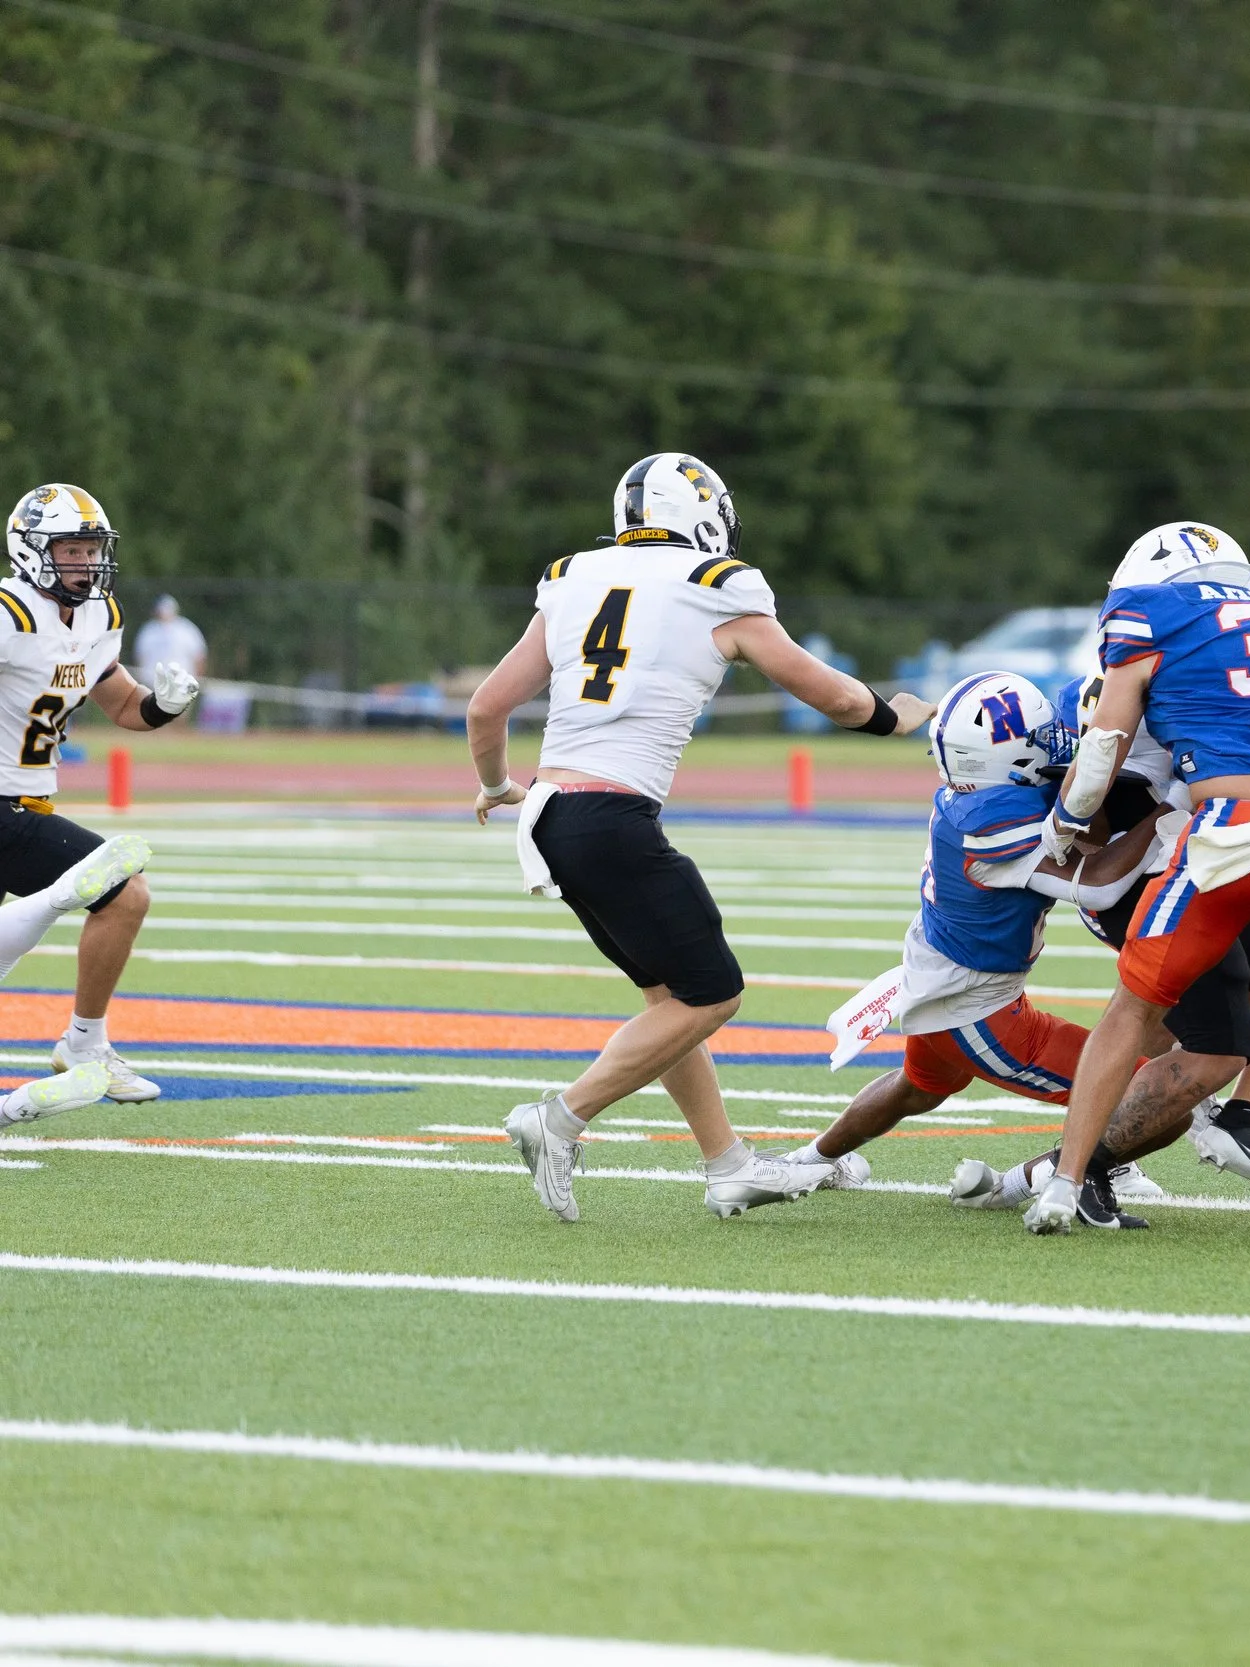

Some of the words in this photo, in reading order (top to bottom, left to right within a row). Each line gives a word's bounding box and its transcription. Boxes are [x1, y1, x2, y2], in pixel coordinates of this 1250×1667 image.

[579, 587, 634, 704] 4
[50, 663, 86, 689] NEERS
[980, 691, 1025, 745] N
[846, 985, 899, 1028] NORTHWEST
